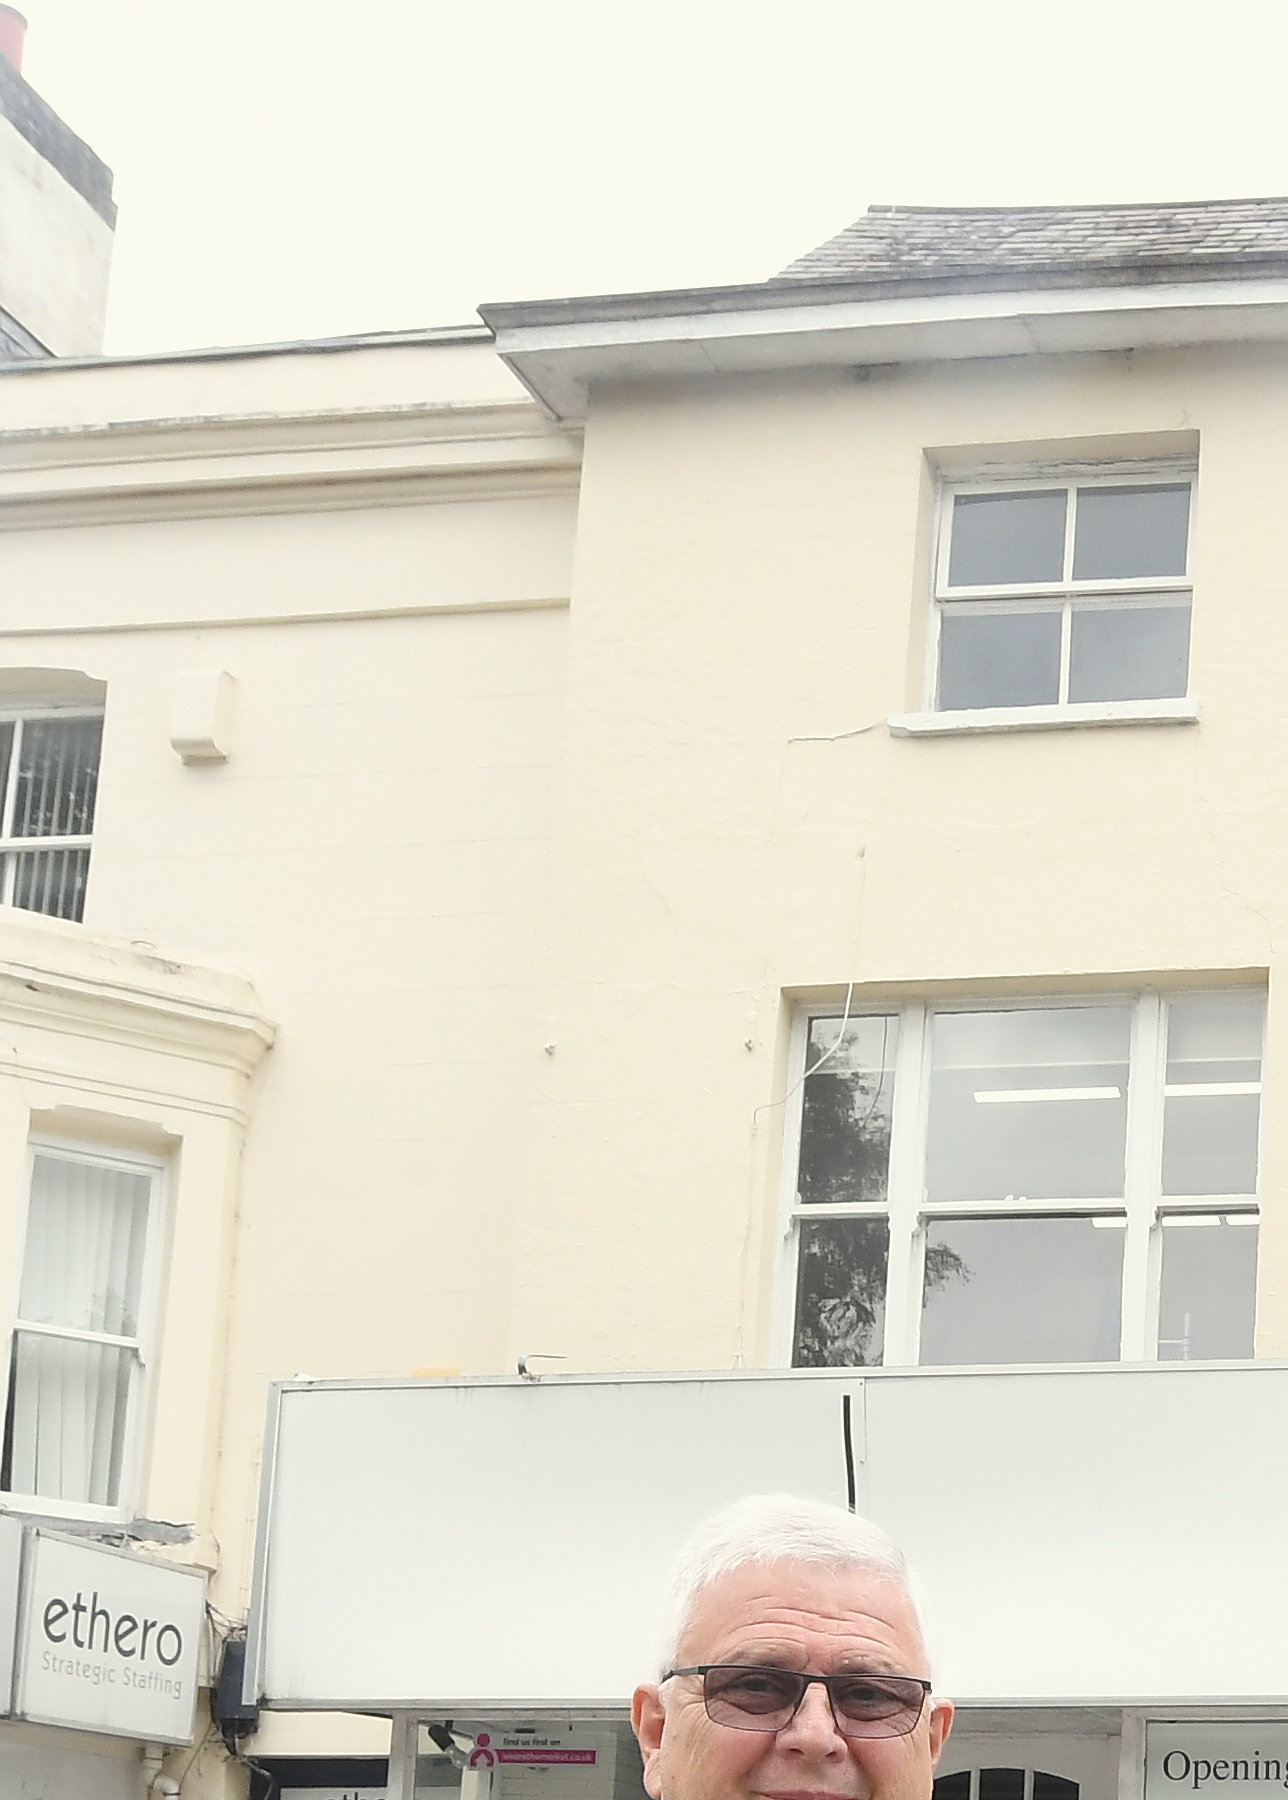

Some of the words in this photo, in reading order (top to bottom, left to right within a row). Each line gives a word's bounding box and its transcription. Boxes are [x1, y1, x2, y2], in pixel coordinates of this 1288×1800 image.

[43, 1591, 182, 1666] ethero
[42, 1650, 116, 1686] Strategic
[123, 1667, 182, 1700] Staffing
